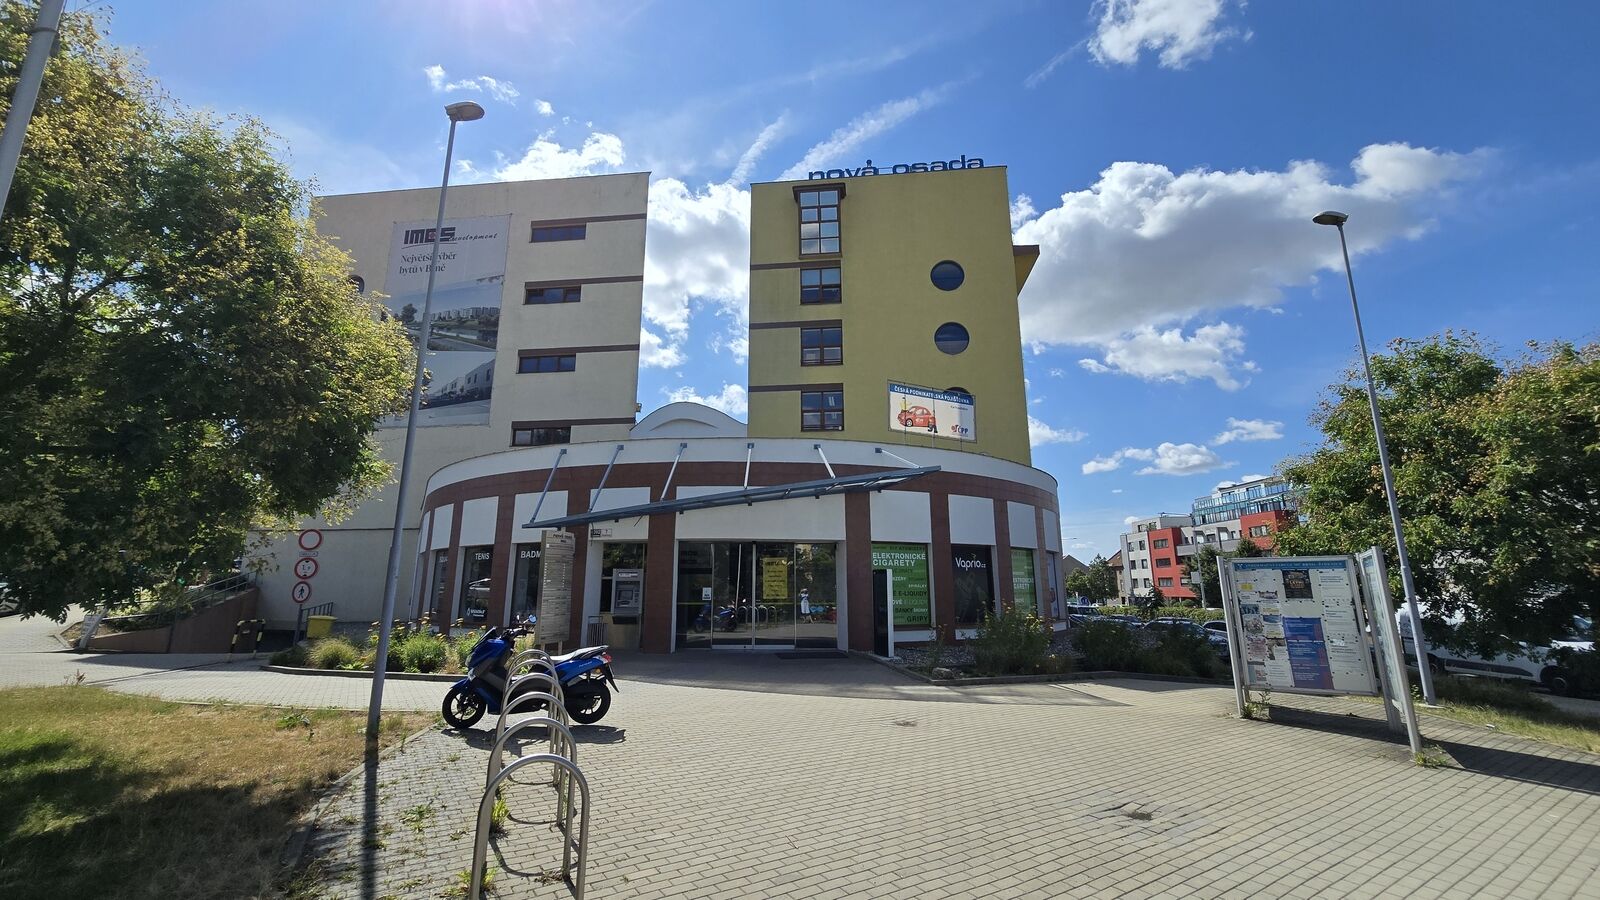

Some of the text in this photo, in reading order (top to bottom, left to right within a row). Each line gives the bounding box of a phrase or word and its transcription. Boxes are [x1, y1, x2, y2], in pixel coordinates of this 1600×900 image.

[892, 154, 984, 175] osada
[404, 227, 456, 244] IMOS
[475, 552, 490, 560] TENIS
